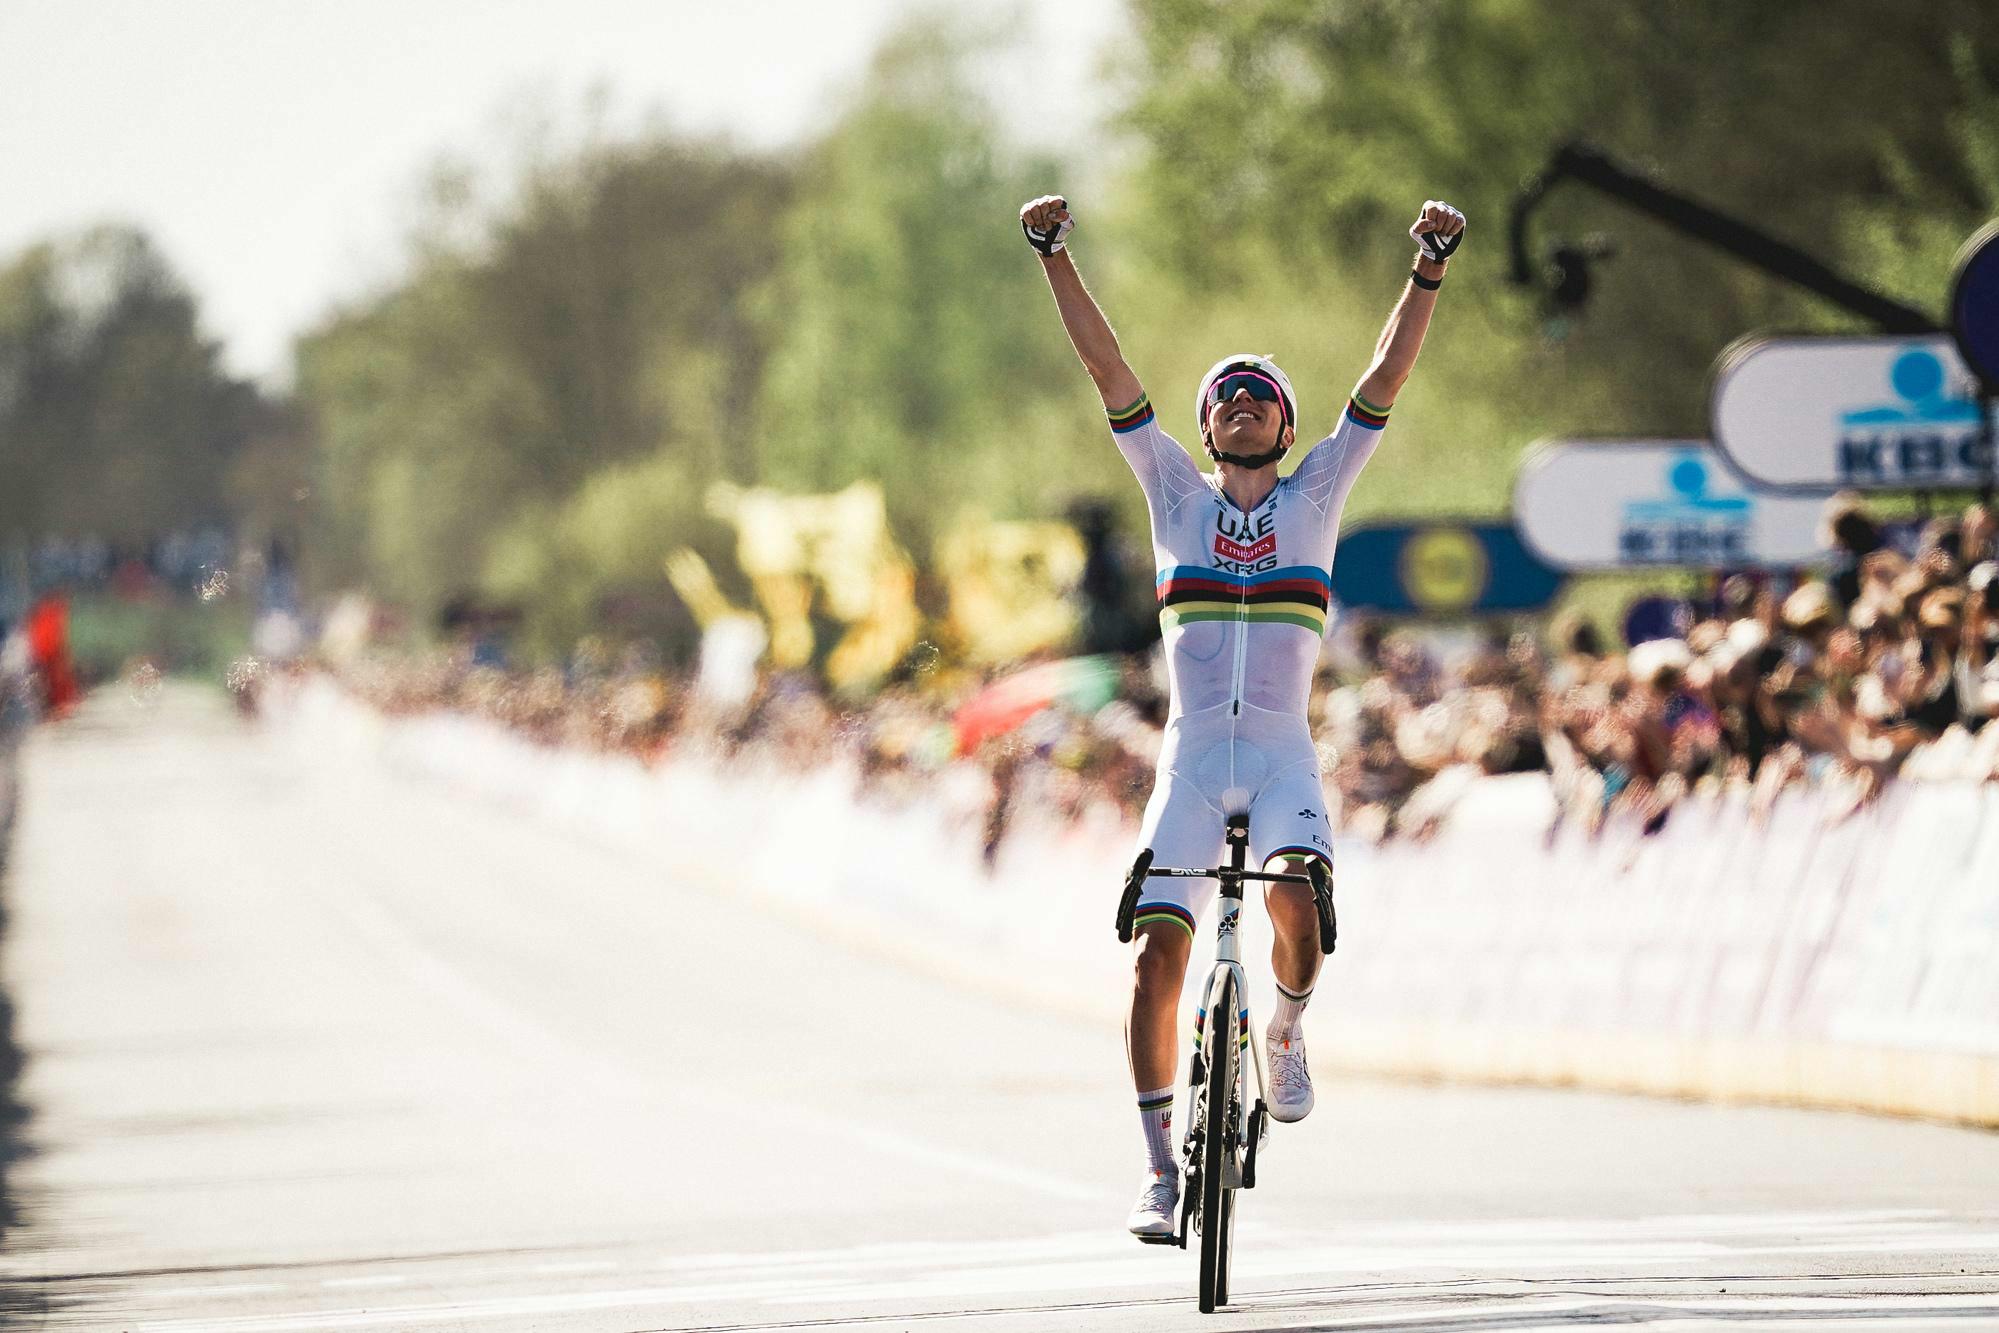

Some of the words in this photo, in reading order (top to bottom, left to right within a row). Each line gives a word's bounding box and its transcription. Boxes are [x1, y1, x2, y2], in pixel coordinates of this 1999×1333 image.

[1217, 510, 1275, 543] UAE
[1220, 541, 1271, 559] Emirates
[1213, 555, 1277, 576] XRG
